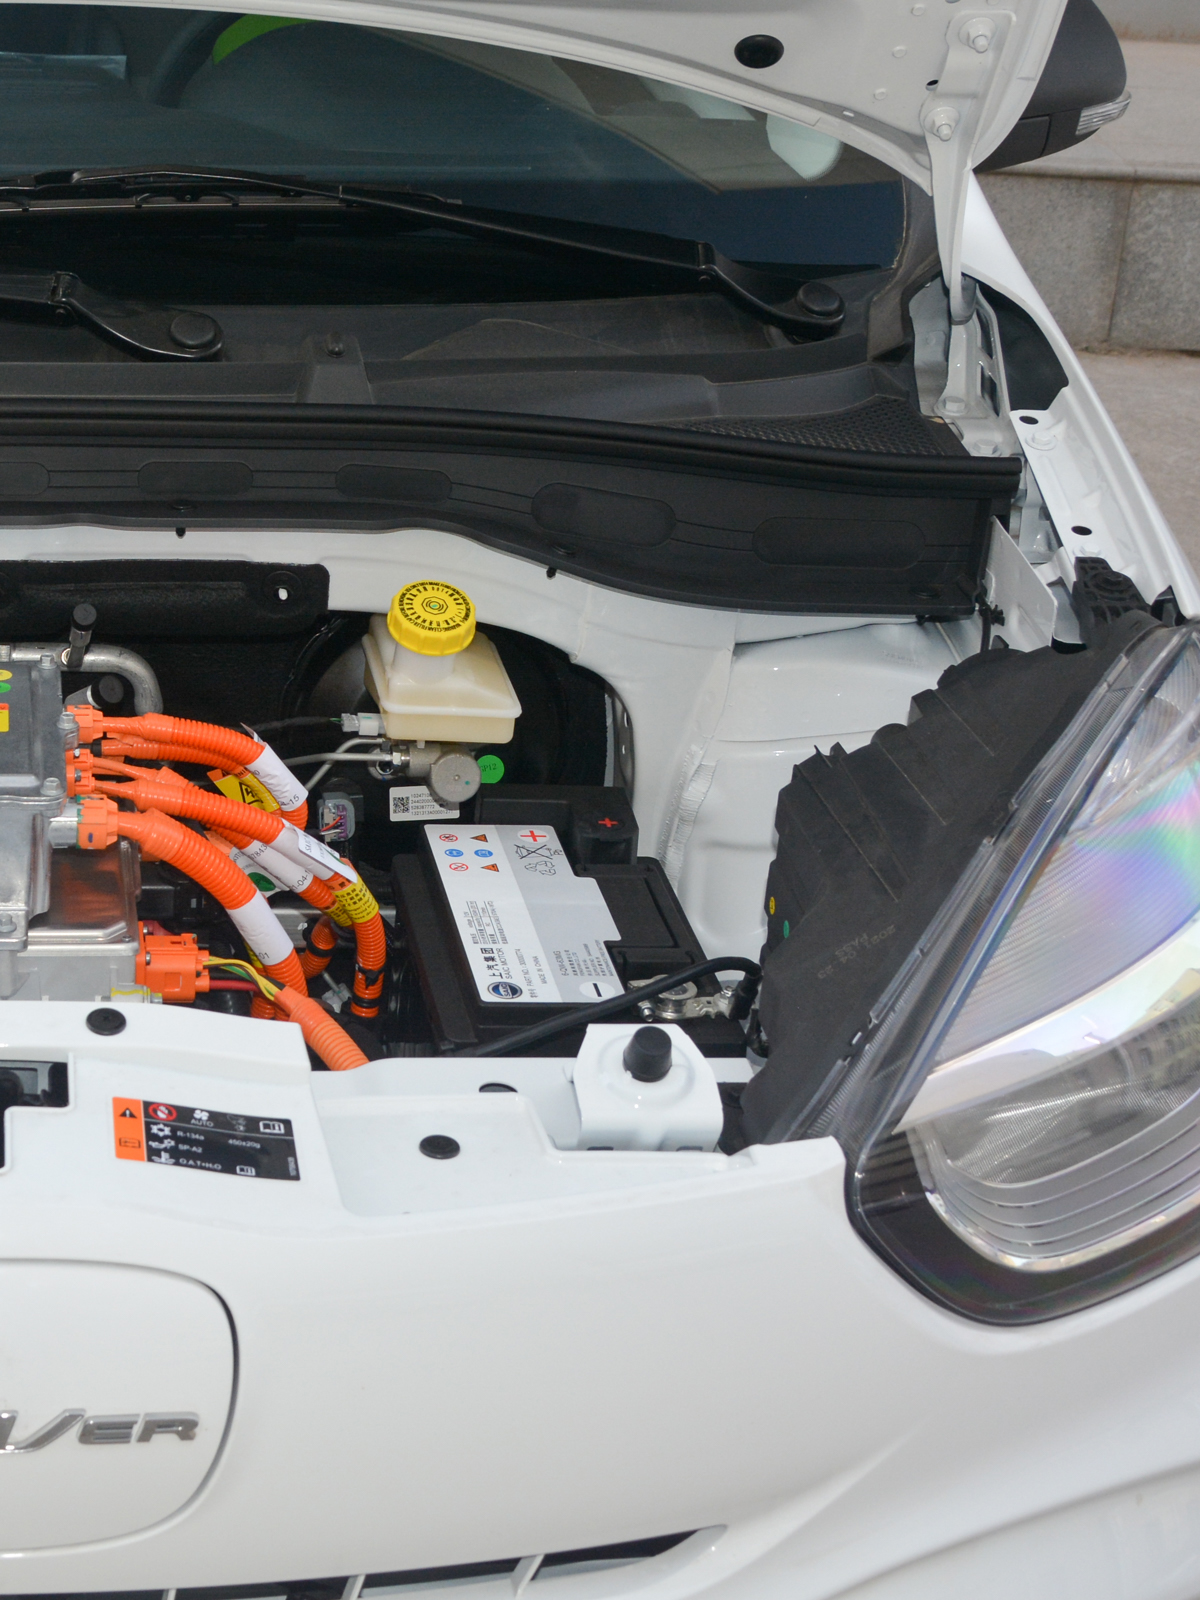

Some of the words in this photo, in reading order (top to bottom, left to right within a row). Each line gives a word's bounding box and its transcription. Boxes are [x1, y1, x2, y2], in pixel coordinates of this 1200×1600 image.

[496, 947, 508, 966] MOTOR
[532, 955, 542, 968] CHINA
[480, 947, 503, 980] 上汽集团
[503, 966, 513, 980] SAIC
[537, 973, 548, 985] MADE
[190, 1118, 214, 1128] AUTO
[176, 1130, 205, 1141] R-134a
[177, 1143, 203, 1154] SP-A2
